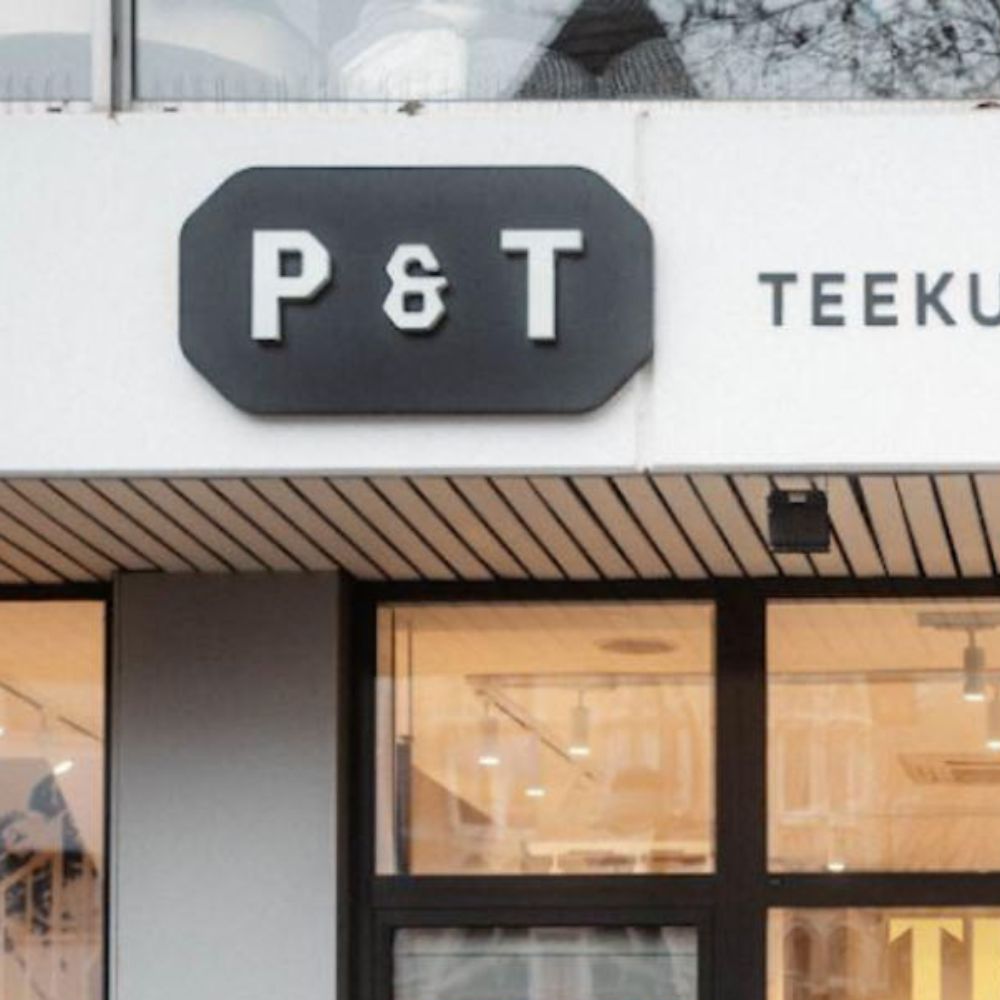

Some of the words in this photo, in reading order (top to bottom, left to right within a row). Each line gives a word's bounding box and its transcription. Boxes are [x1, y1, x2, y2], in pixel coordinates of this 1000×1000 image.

[250, 230, 331, 342] P
[383, 244, 447, 331] &
[501, 230, 583, 341] T
